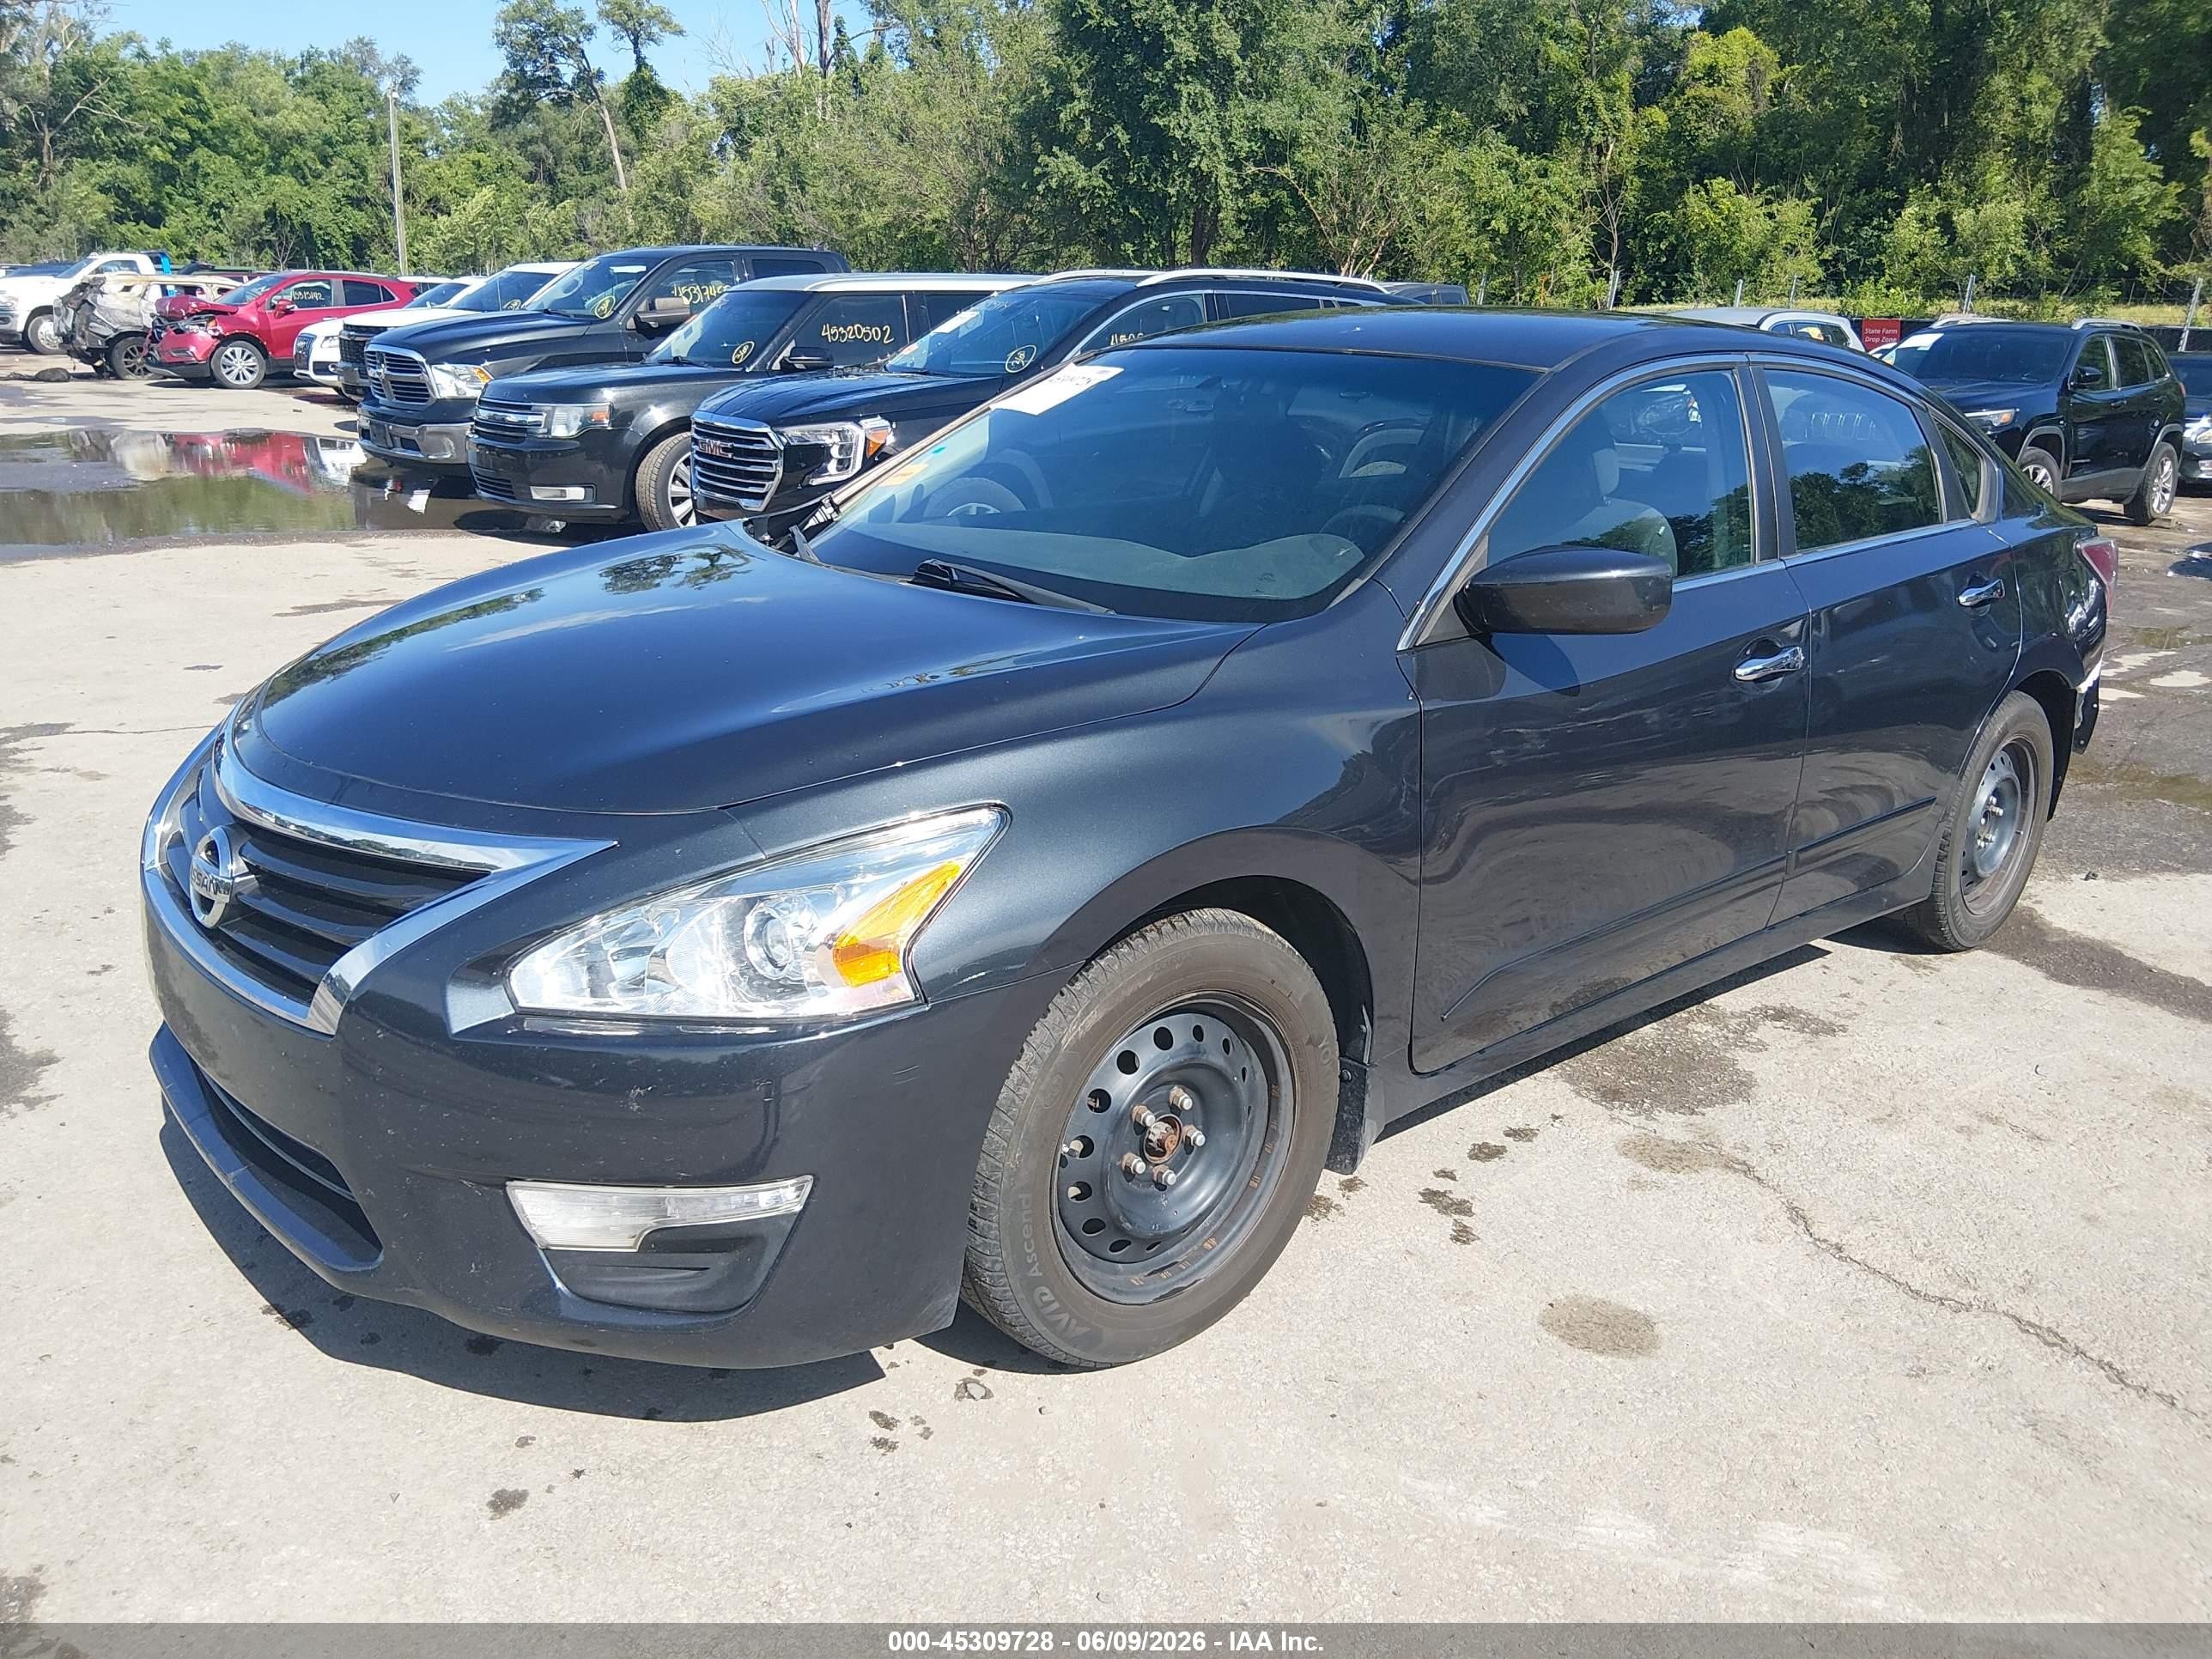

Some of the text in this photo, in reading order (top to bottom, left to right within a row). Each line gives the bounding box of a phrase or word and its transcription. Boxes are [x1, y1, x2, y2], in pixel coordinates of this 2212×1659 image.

[821, 323, 895, 344] 45320502
[698, 439, 733, 459] GMC
[1018, 1193, 1091, 1339] AVID Ascend
